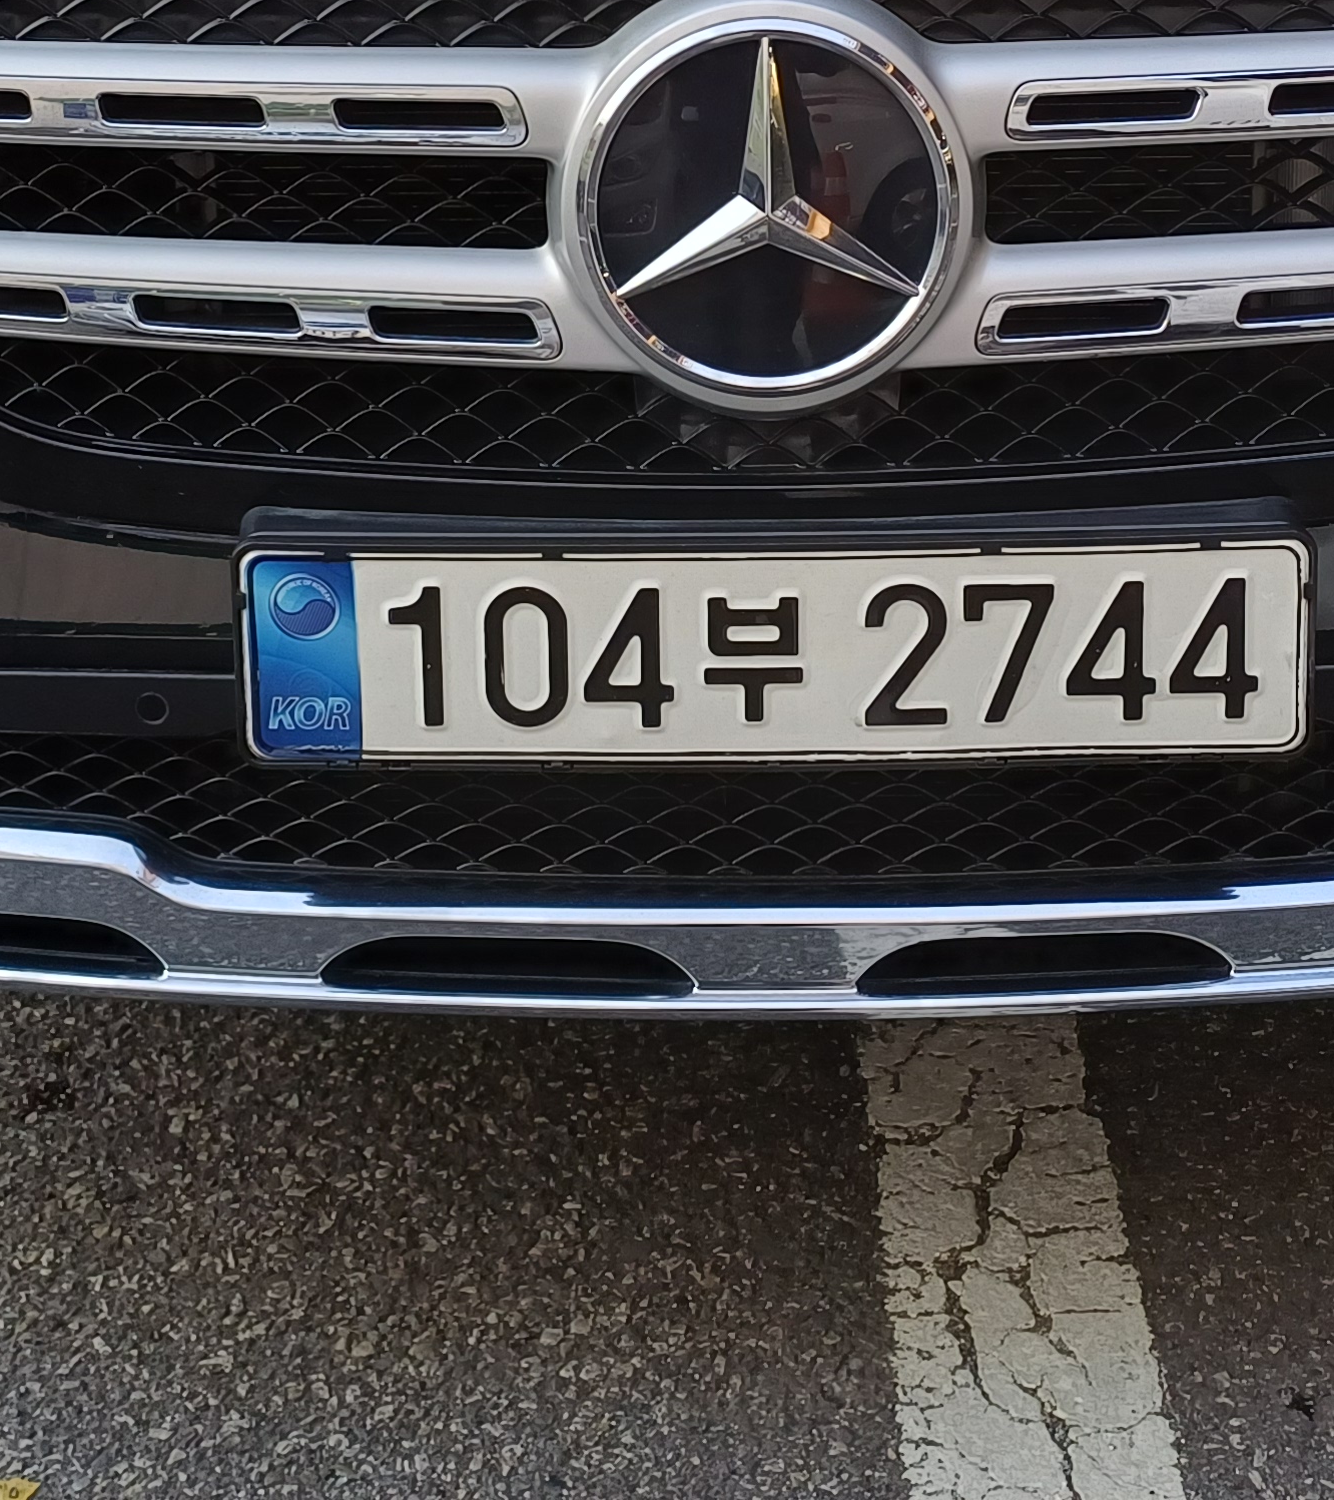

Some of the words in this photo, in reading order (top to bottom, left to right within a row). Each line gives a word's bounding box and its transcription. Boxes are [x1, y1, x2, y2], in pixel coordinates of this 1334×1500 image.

[387, 584, 804, 728] 104부
[862, 576, 1260, 728] 2744
[268, 695, 351, 731] KOR
